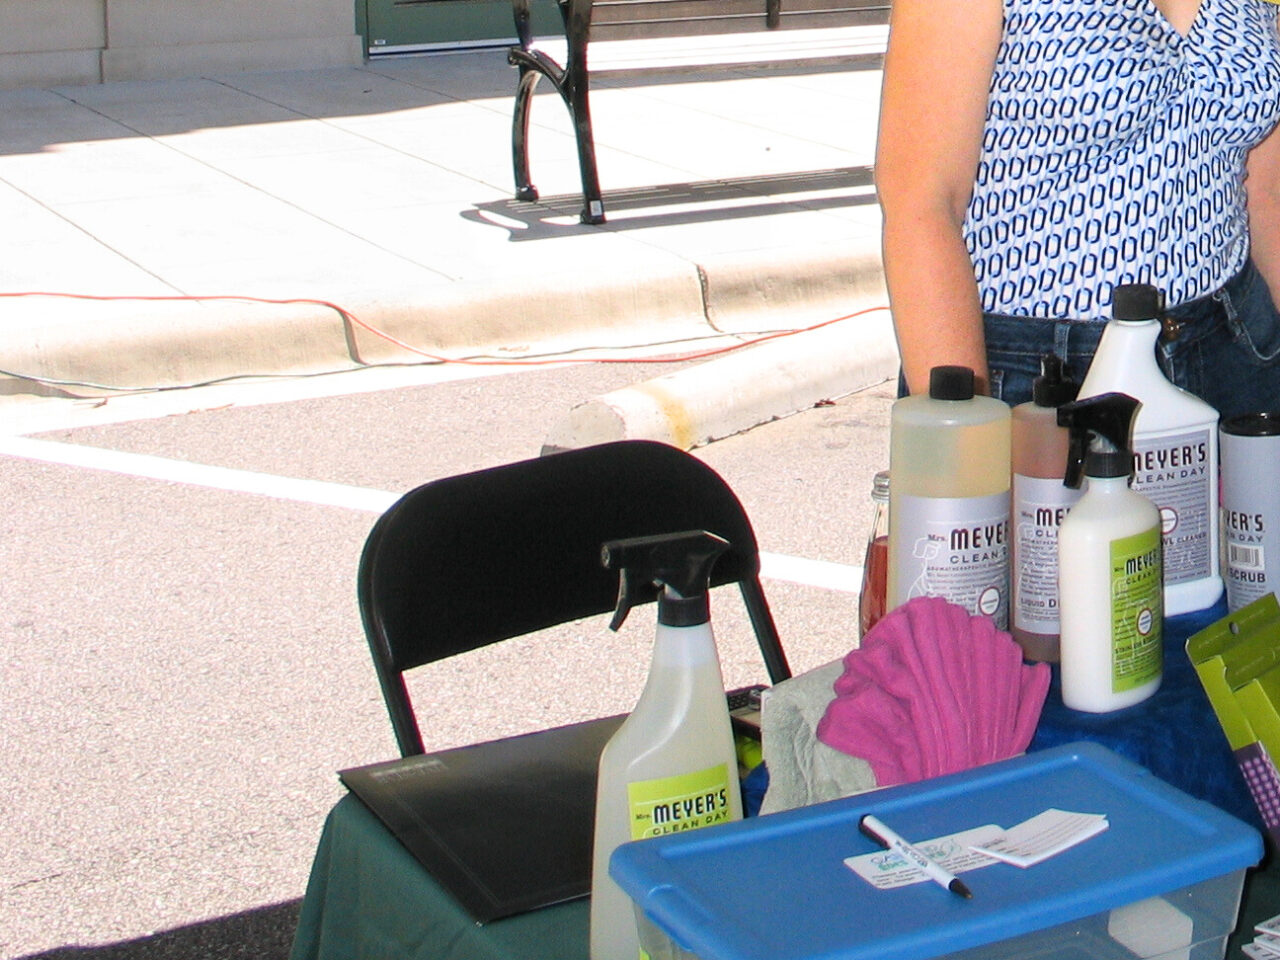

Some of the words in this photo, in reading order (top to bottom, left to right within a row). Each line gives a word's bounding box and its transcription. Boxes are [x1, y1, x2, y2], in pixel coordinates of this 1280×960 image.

[1136, 471, 1175, 484] LEAN
[1180, 465, 1206, 479] DAY
[1036, 507, 1070, 527] ME
[928, 534, 946, 542] Mrs.
[1035, 529, 1059, 538] CL
[1239, 534, 1263, 542] DAY
[950, 550, 999, 565] CLEAN
[1229, 567, 1266, 583] SCRUB
[653, 788, 728, 825] MEYER'S
[653, 820, 699, 836] CLEAN
[705, 809, 729, 824] DAY
